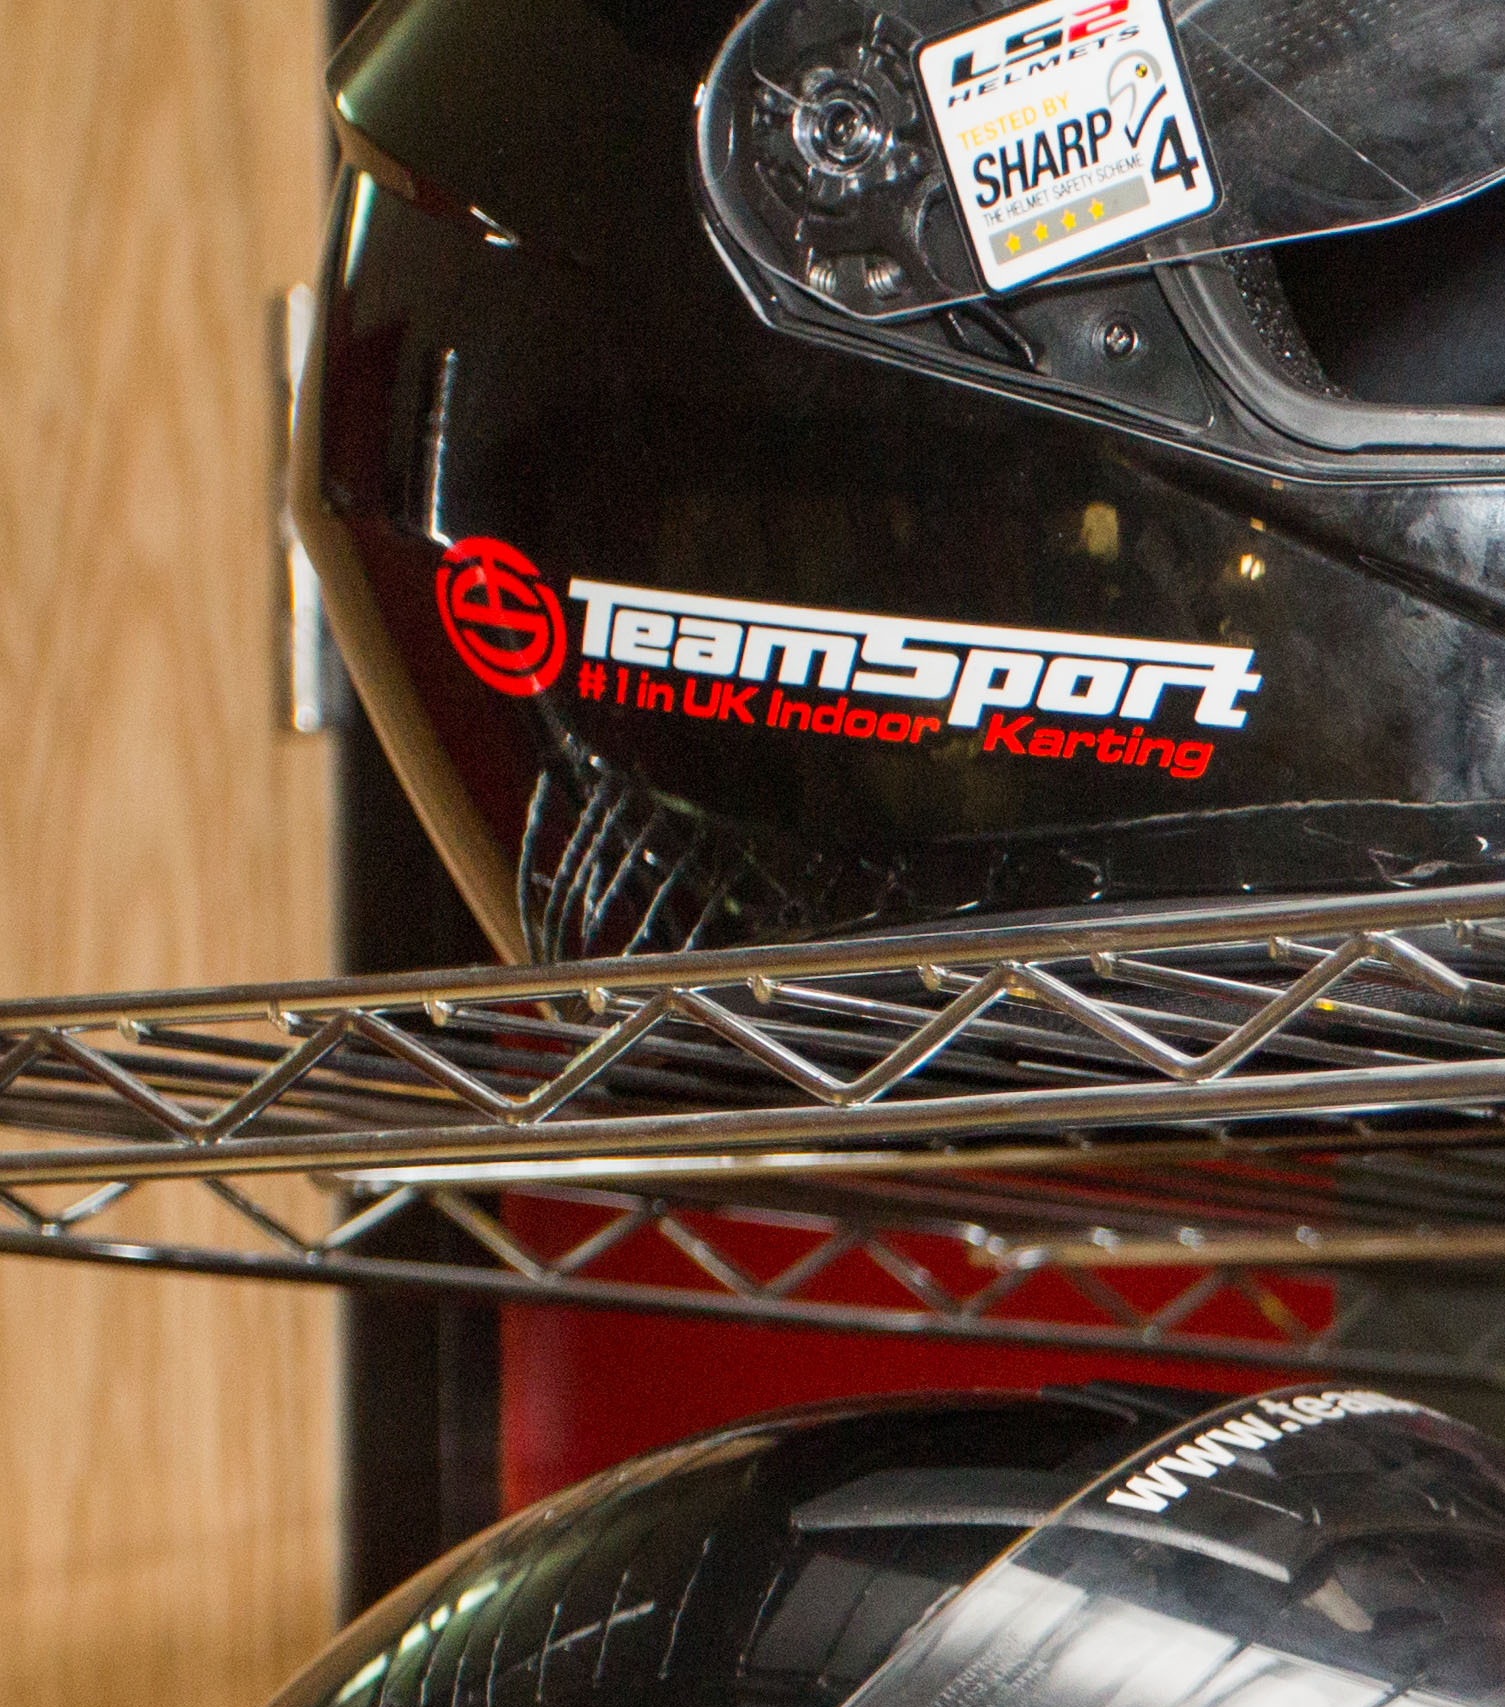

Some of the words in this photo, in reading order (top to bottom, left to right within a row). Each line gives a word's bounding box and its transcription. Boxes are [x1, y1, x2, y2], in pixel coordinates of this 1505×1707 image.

[948, 25, 1140, 108] HELMETS
[952, 0, 1129, 86] LS2
[957, 107, 1038, 150] TESTED
[1043, 91, 1070, 118] BY
[972, 107, 1112, 208] SHARP
[1150, 114, 1199, 191] 4
[982, 208, 1003, 227] THE
[1006, 189, 1049, 215] HELMET
[1052, 174, 1094, 200] SAFETY
[1096, 152, 1144, 183] SCHEME
[568, 577, 1263, 728] TeamSport
[636, 671, 674, 712] in
[682, 678, 759, 724] UK
[766, 688, 941, 744] Indoor
[984, 713, 1215, 780] Karting
